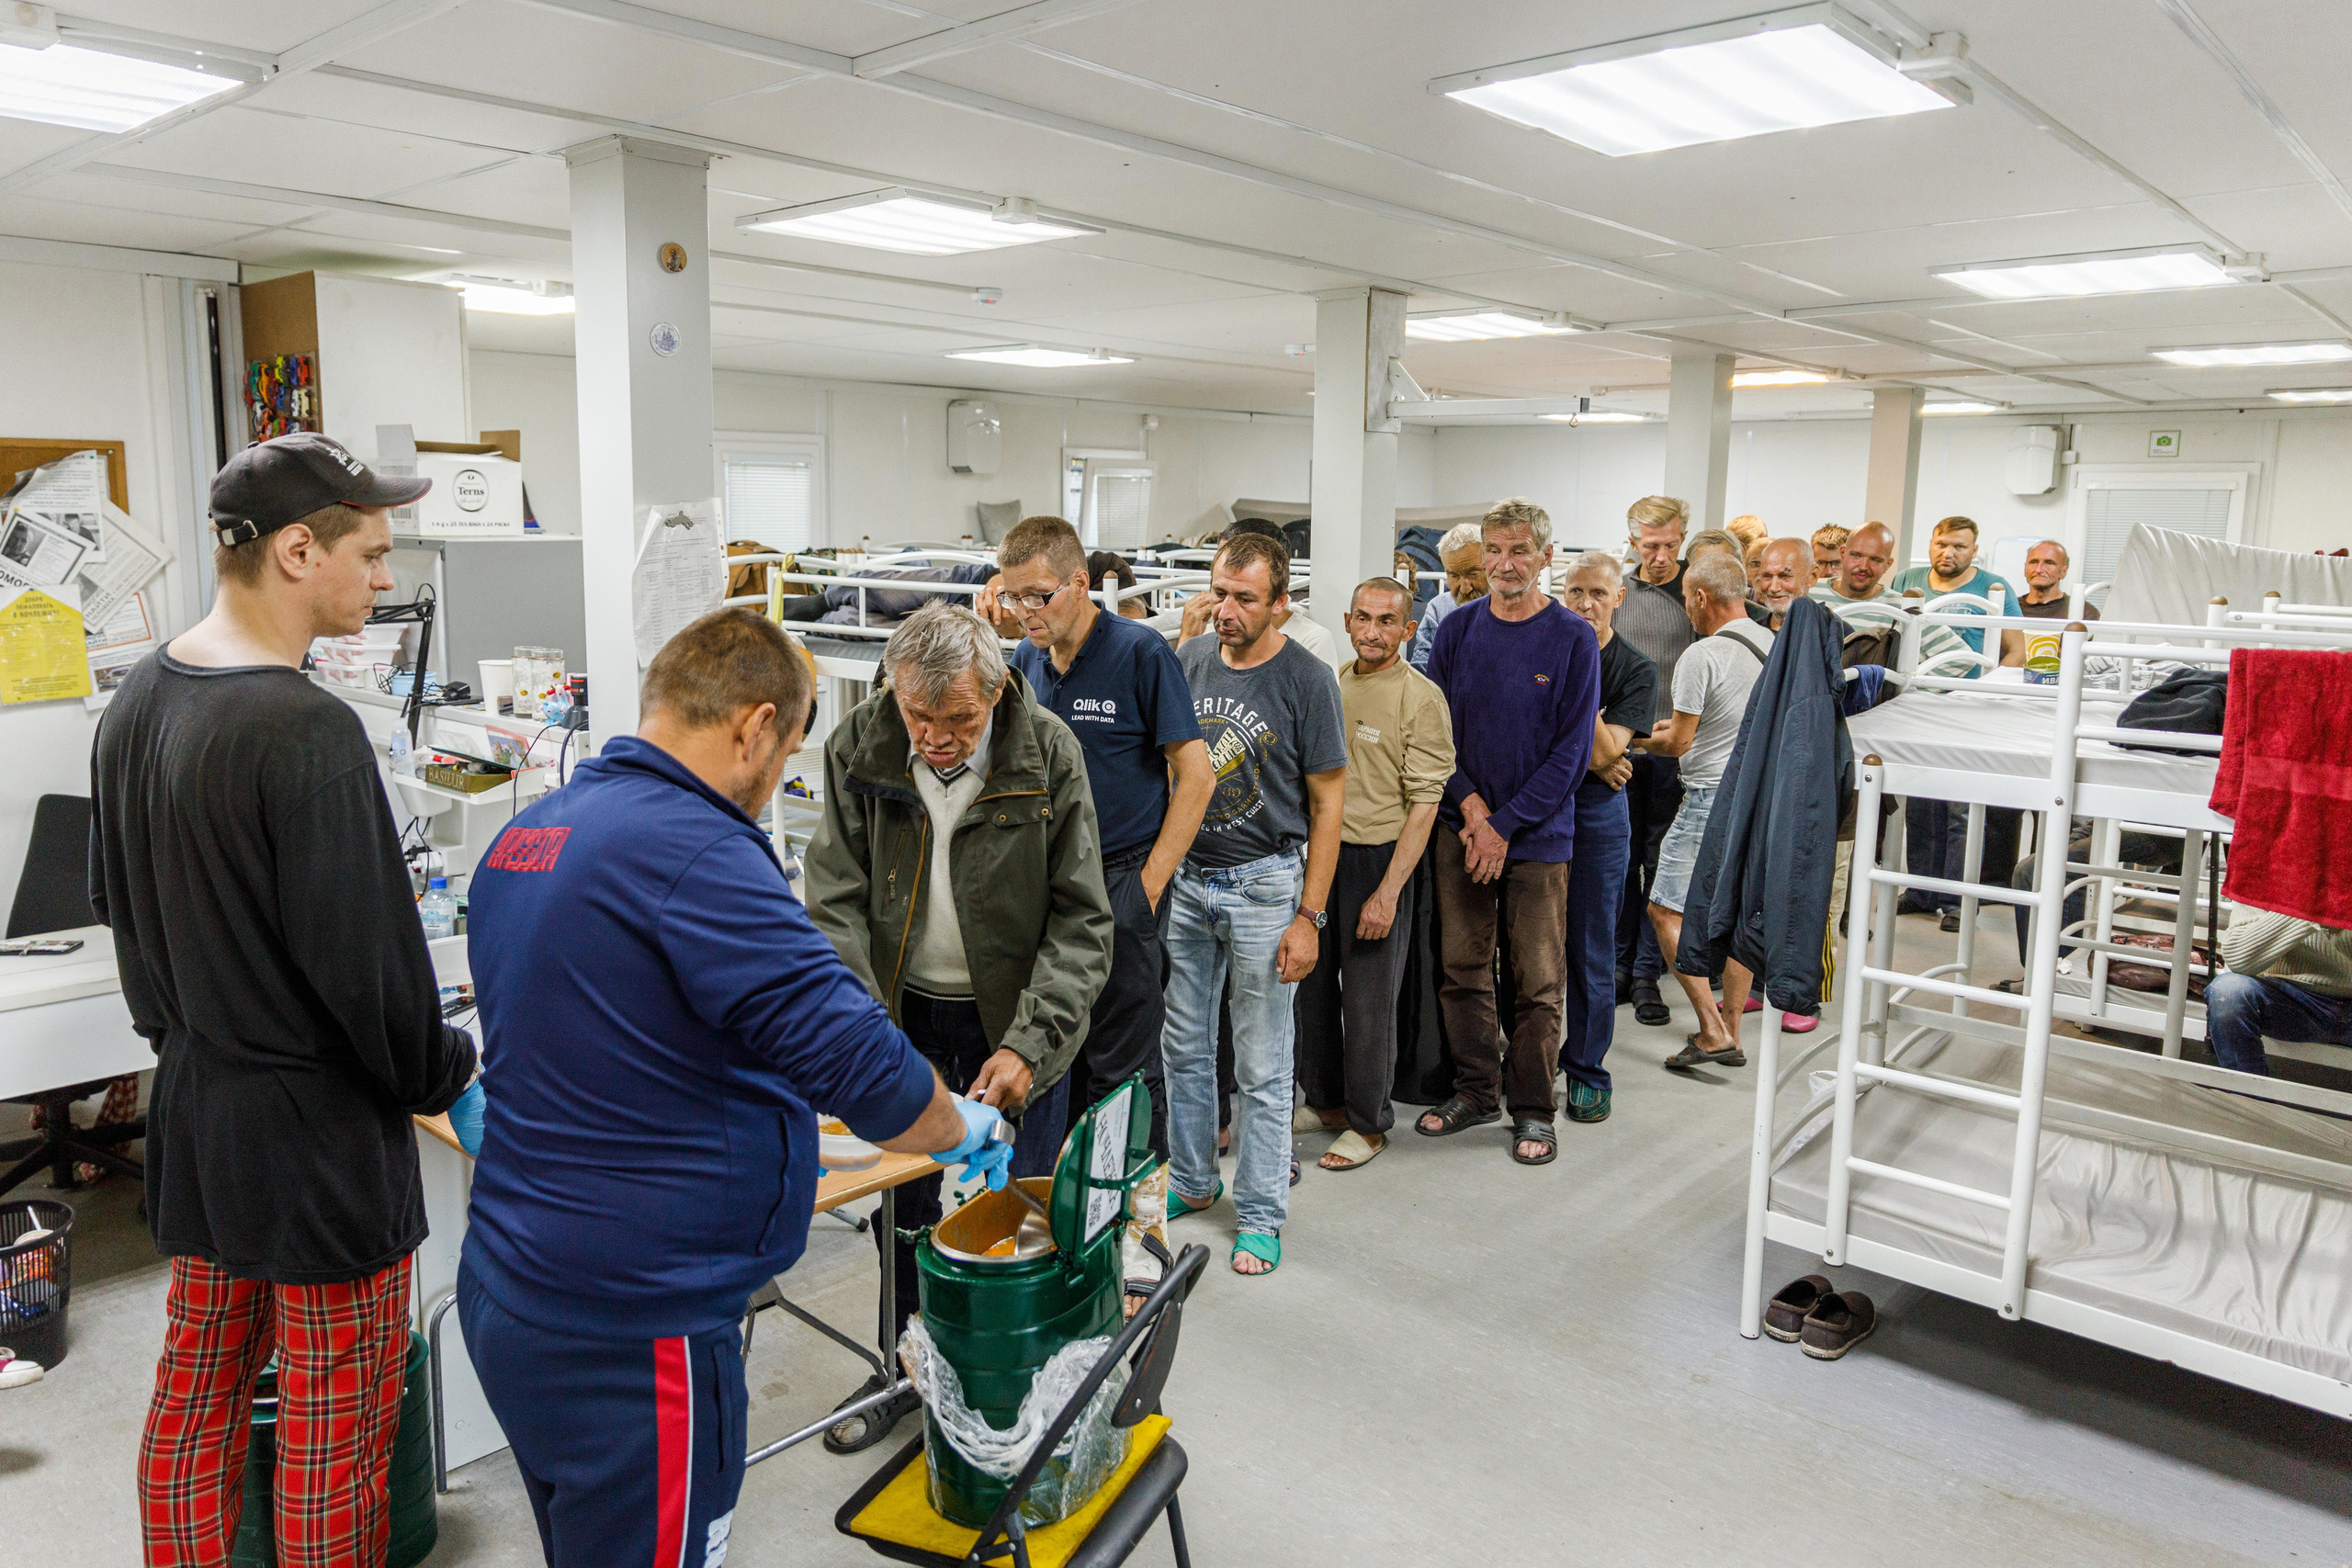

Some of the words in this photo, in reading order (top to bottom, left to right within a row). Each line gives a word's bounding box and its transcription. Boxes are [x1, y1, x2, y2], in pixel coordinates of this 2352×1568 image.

[457, 486, 485, 496] Terns
[1073, 698, 1101, 711] Qlik
[1193, 696, 1269, 738] ERITAGE
[1355, 730, 1379, 744] РОССИИ
[1358, 725, 1381, 736] АРМИЯ
[428, 766, 465, 791] BASILUR
[1224, 816, 1246, 830] WEST
[1095, 1110, 1119, 1212] НОЧЛЕЖА
